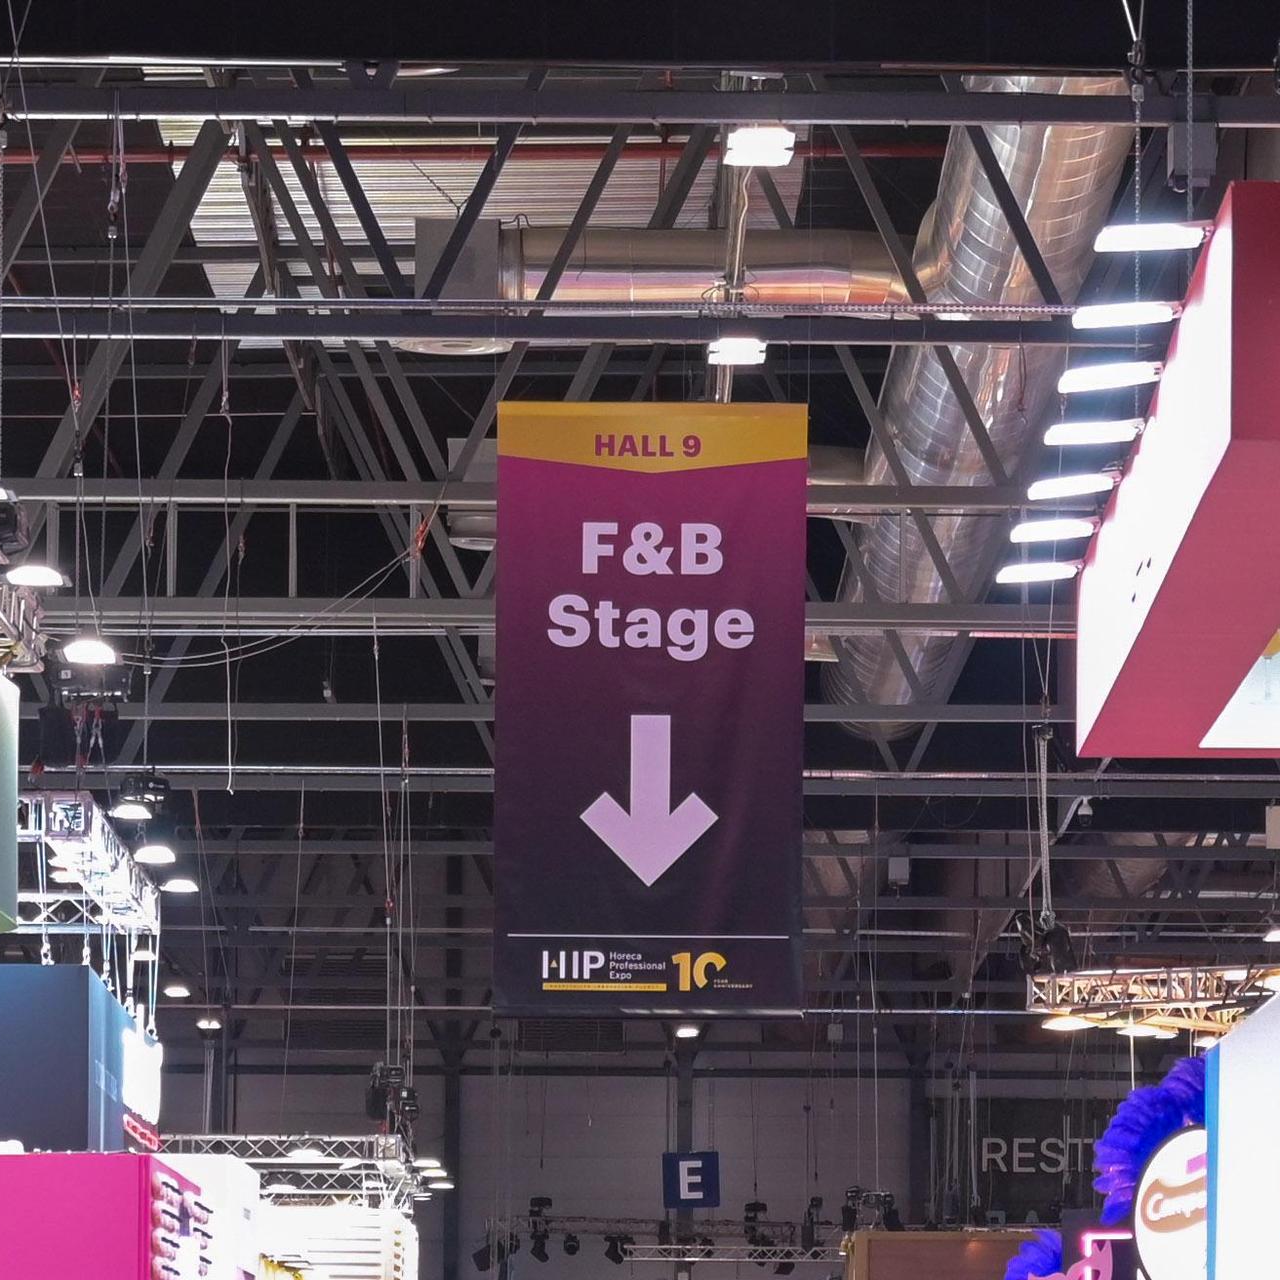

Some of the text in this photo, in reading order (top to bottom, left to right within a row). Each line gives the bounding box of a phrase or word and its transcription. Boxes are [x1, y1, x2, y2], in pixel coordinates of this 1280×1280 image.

[594, 434, 702, 457] HALL 9
[582, 522, 724, 576] F&B
[547, 594, 756, 662] Stage
[542, 951, 605, 979] HIP
[609, 952, 642, 960] Horeca
[609, 961, 666, 970] Professional
[609, 971, 632, 980] Expo
[679, 1160, 704, 1200] E
